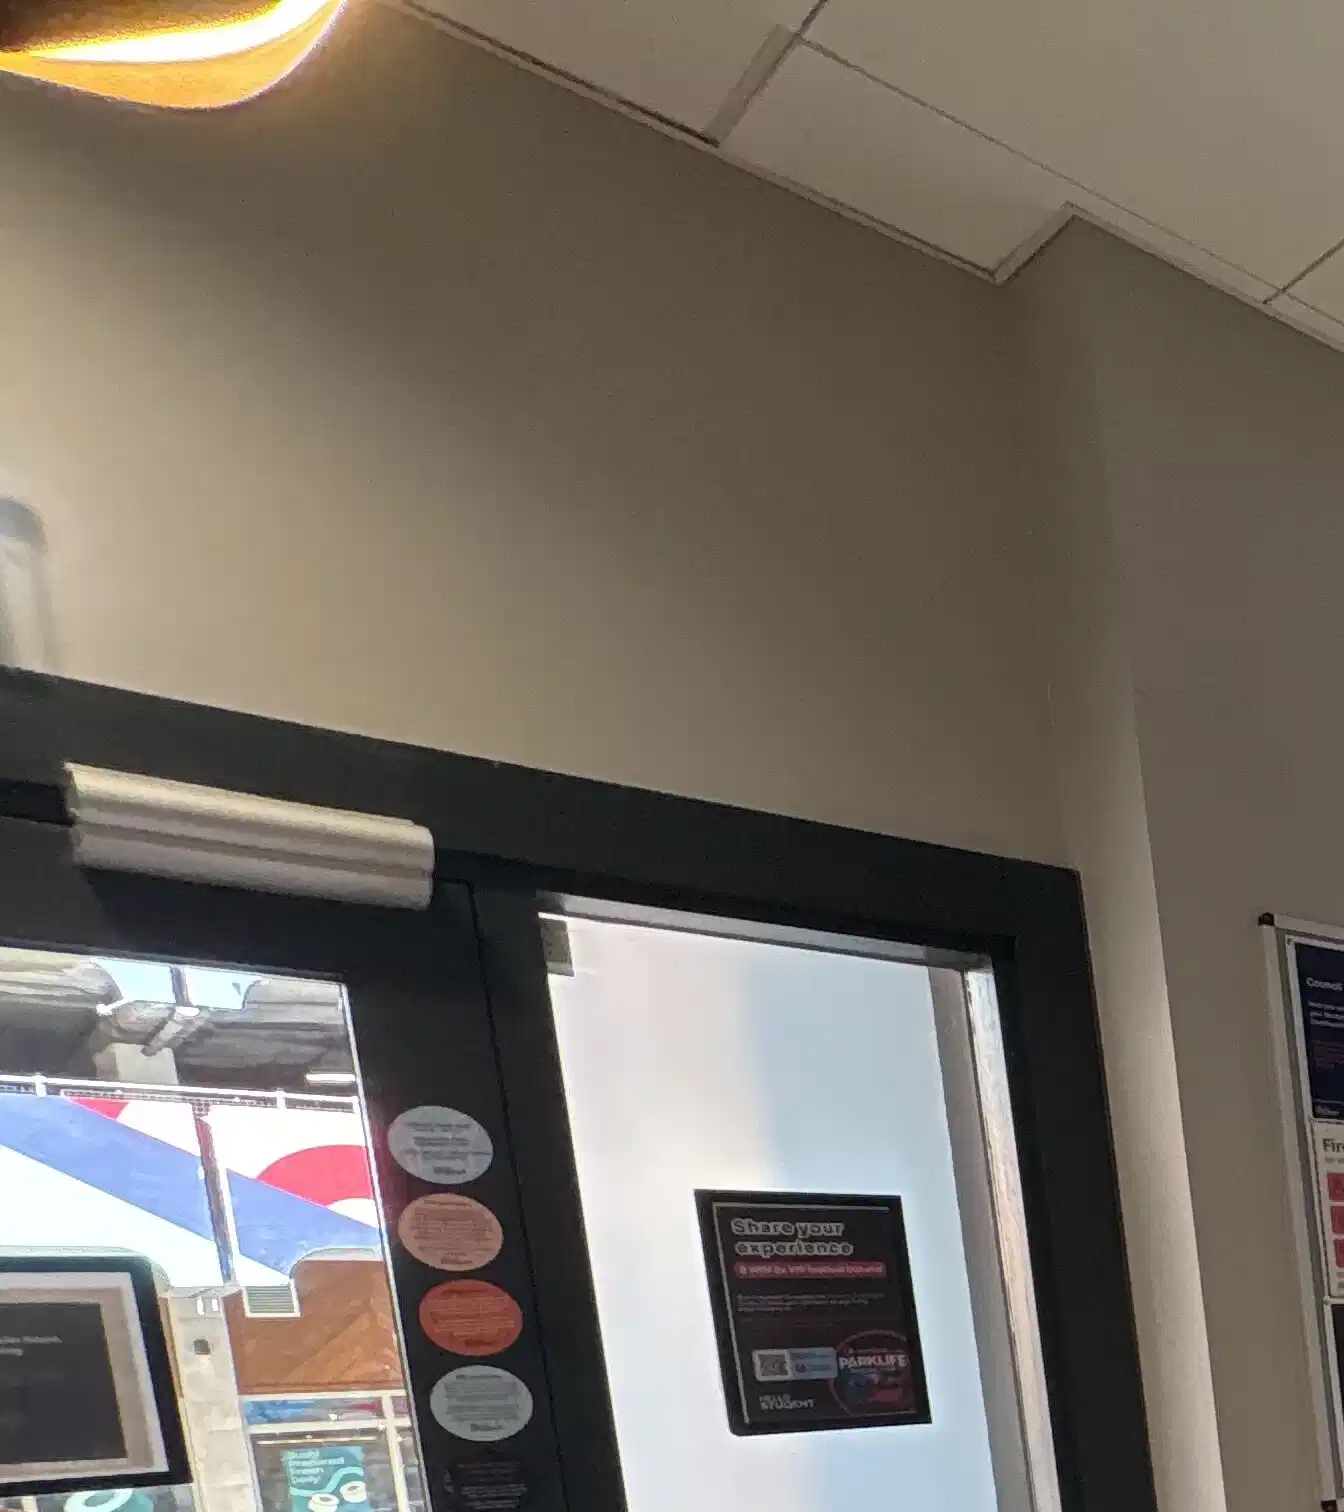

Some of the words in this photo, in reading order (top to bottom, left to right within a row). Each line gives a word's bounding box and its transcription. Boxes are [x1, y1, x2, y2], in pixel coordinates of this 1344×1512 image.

[730, 1218, 795, 1236] Share
[796, 1221, 845, 1239] your
[734, 1239, 855, 1258] experience
